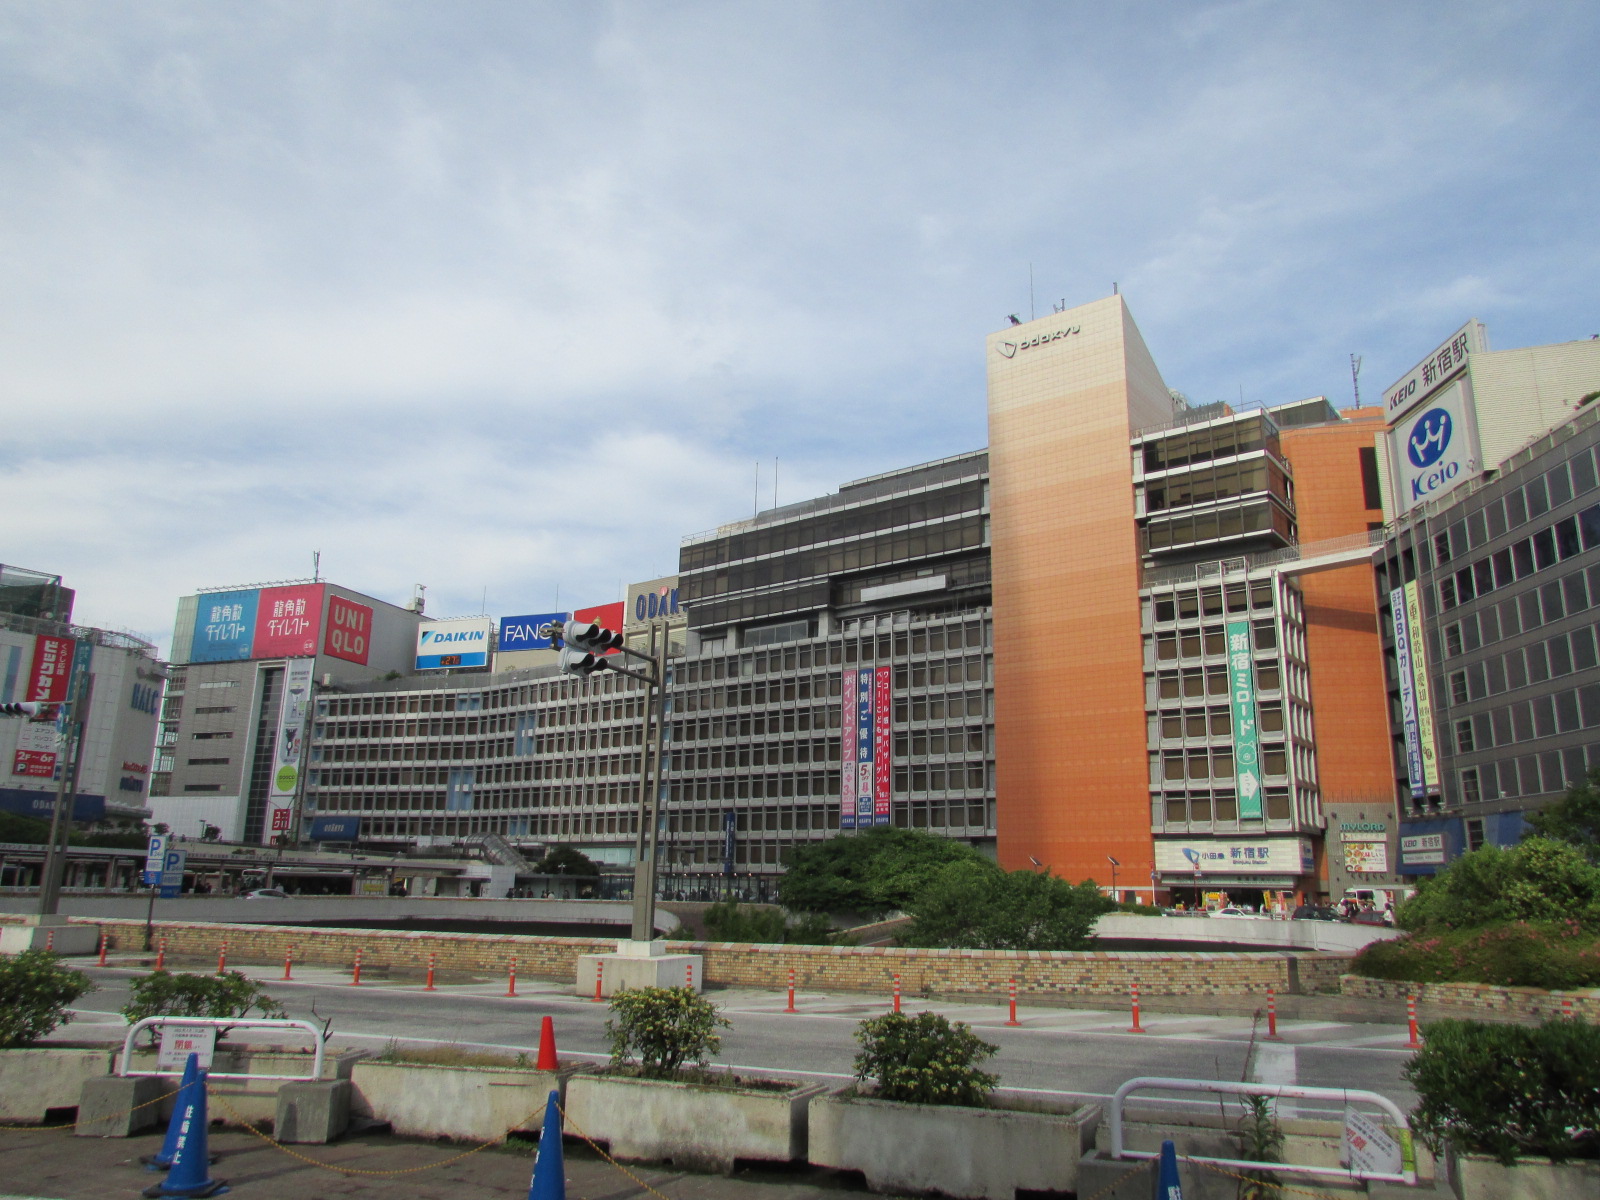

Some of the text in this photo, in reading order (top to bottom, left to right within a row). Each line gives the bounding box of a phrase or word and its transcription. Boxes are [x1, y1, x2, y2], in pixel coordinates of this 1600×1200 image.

[1388, 332, 1470, 411] KEIO 新宿駅
[1411, 460, 1459, 501] Keio
[210, 603, 244, 623] 龍角散
[273, 598, 306, 618] 龍角散
[334, 604, 365, 632] UNI
[205, 622, 246, 642] ダイレクト
[267, 617, 310, 637] ダイレクト
[433, 630, 484, 643] DAIKIN
[331, 629, 365, 655] QLO
[1395, 607, 1413, 718] BBQガーデン
[1229, 632, 1254, 737] 新宿ミロード
[859, 672, 869, 760] 特別ご優待
[17, 763, 26, 772] P
[150, 839, 161, 857] P
[1230, 847, 1270, 859] 新宿駅
[166, 853, 180, 871] P
